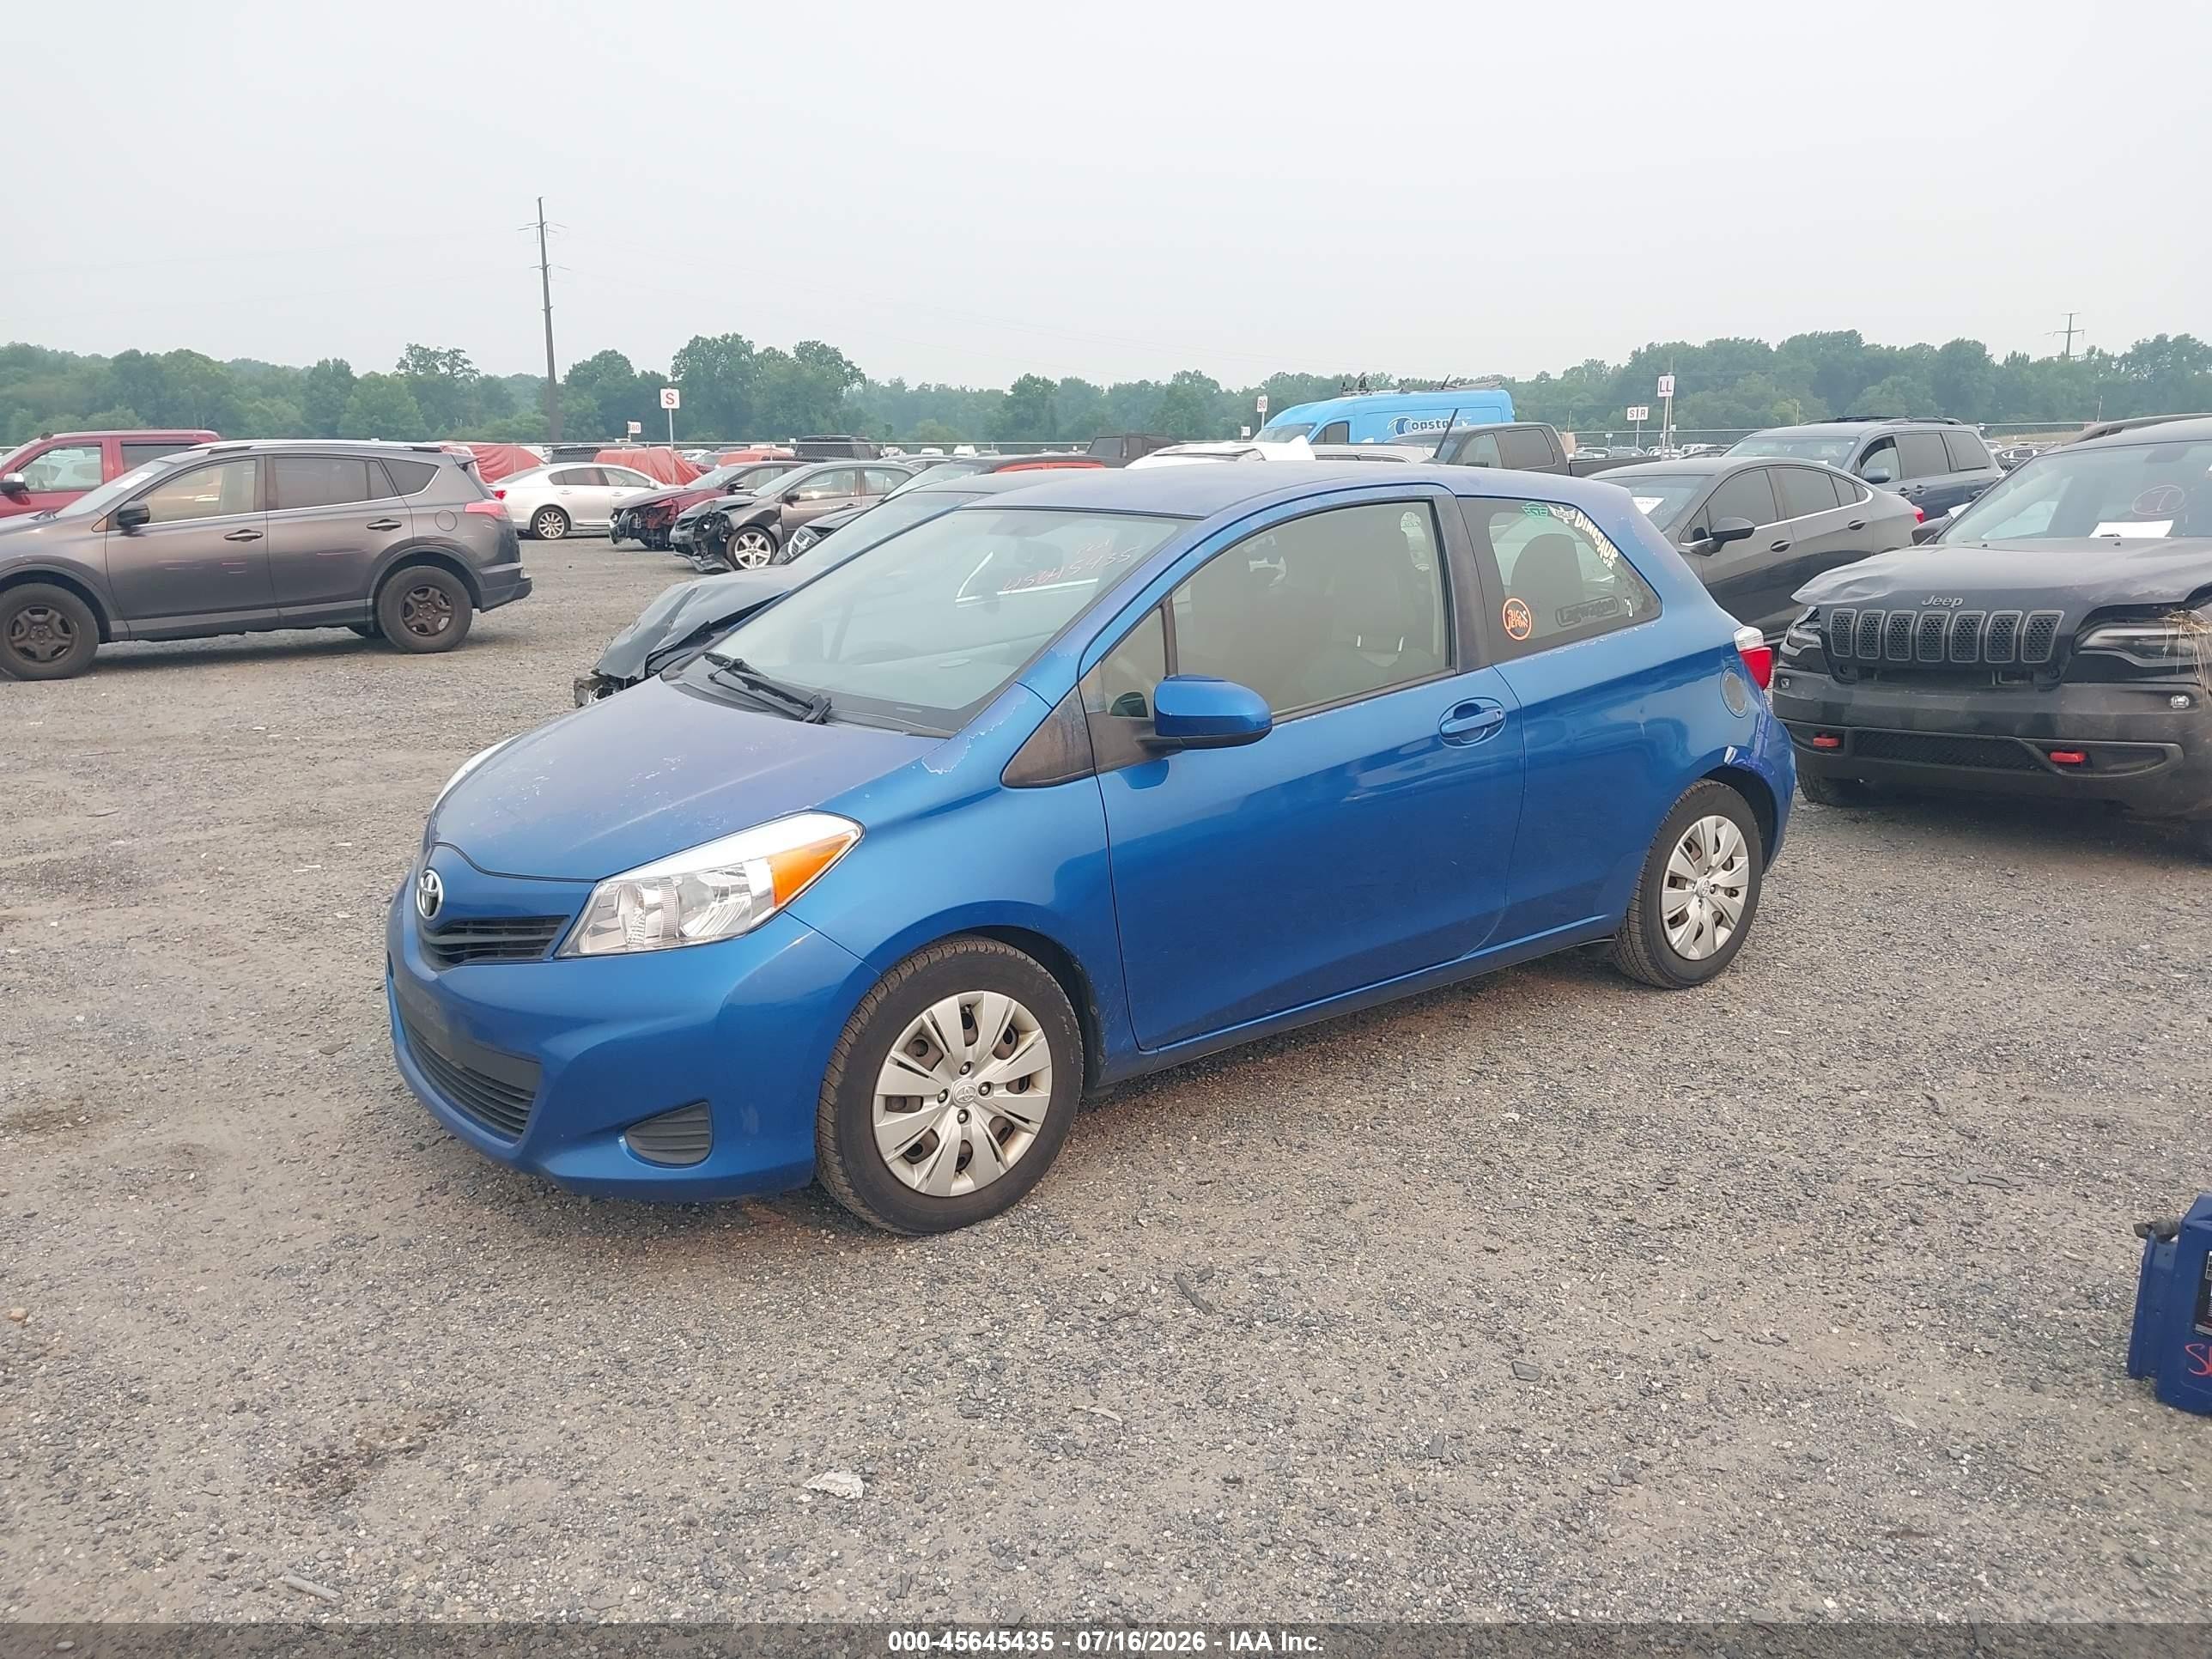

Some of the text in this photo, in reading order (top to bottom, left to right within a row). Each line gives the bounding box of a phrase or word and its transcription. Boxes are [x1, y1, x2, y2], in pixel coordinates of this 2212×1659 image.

[1659, 380, 1673, 392] LL
[665, 392, 675, 405] S
[1574, 510, 1619, 564] DINOSAUR
[1921, 594, 1964, 608] Jeep
